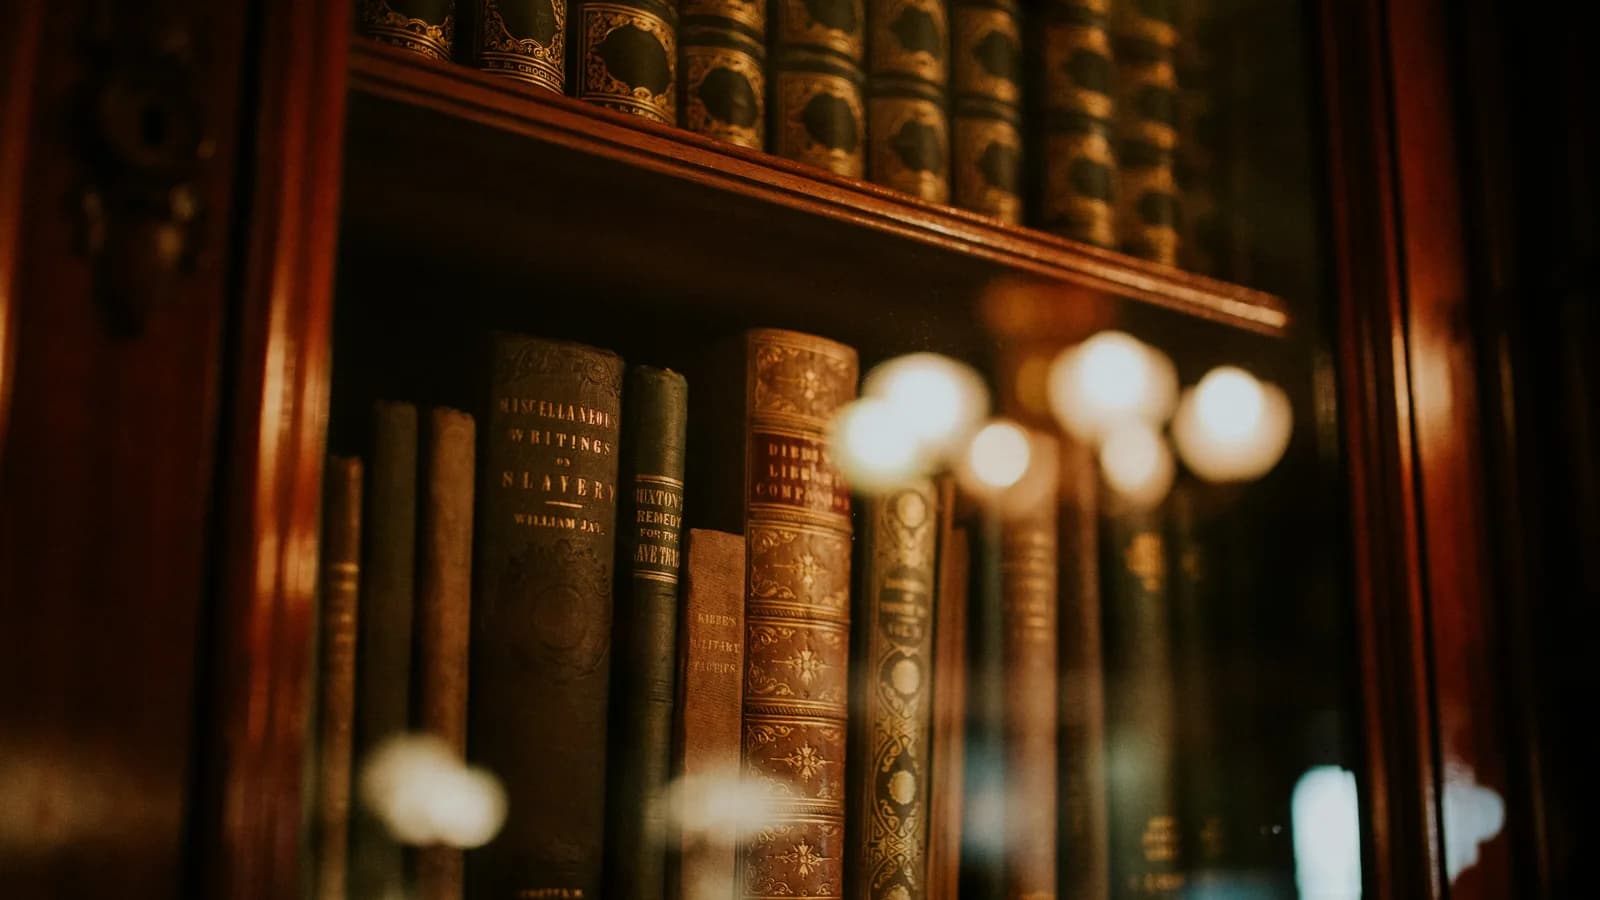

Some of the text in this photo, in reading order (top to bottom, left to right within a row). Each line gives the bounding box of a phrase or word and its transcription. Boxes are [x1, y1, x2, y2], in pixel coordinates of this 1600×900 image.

[500, 398, 618, 429] MISCELLANEOUS
[511, 427, 611, 455] WRITINGS
[556, 457, 571, 467] ON
[502, 471, 615, 503] SLAVERY
[513, 513, 576, 529] WILLIAM
[637, 510, 682, 528] REMEDY
[640, 528, 679, 543] FOR THE
[633, 543, 657, 564] AVE
